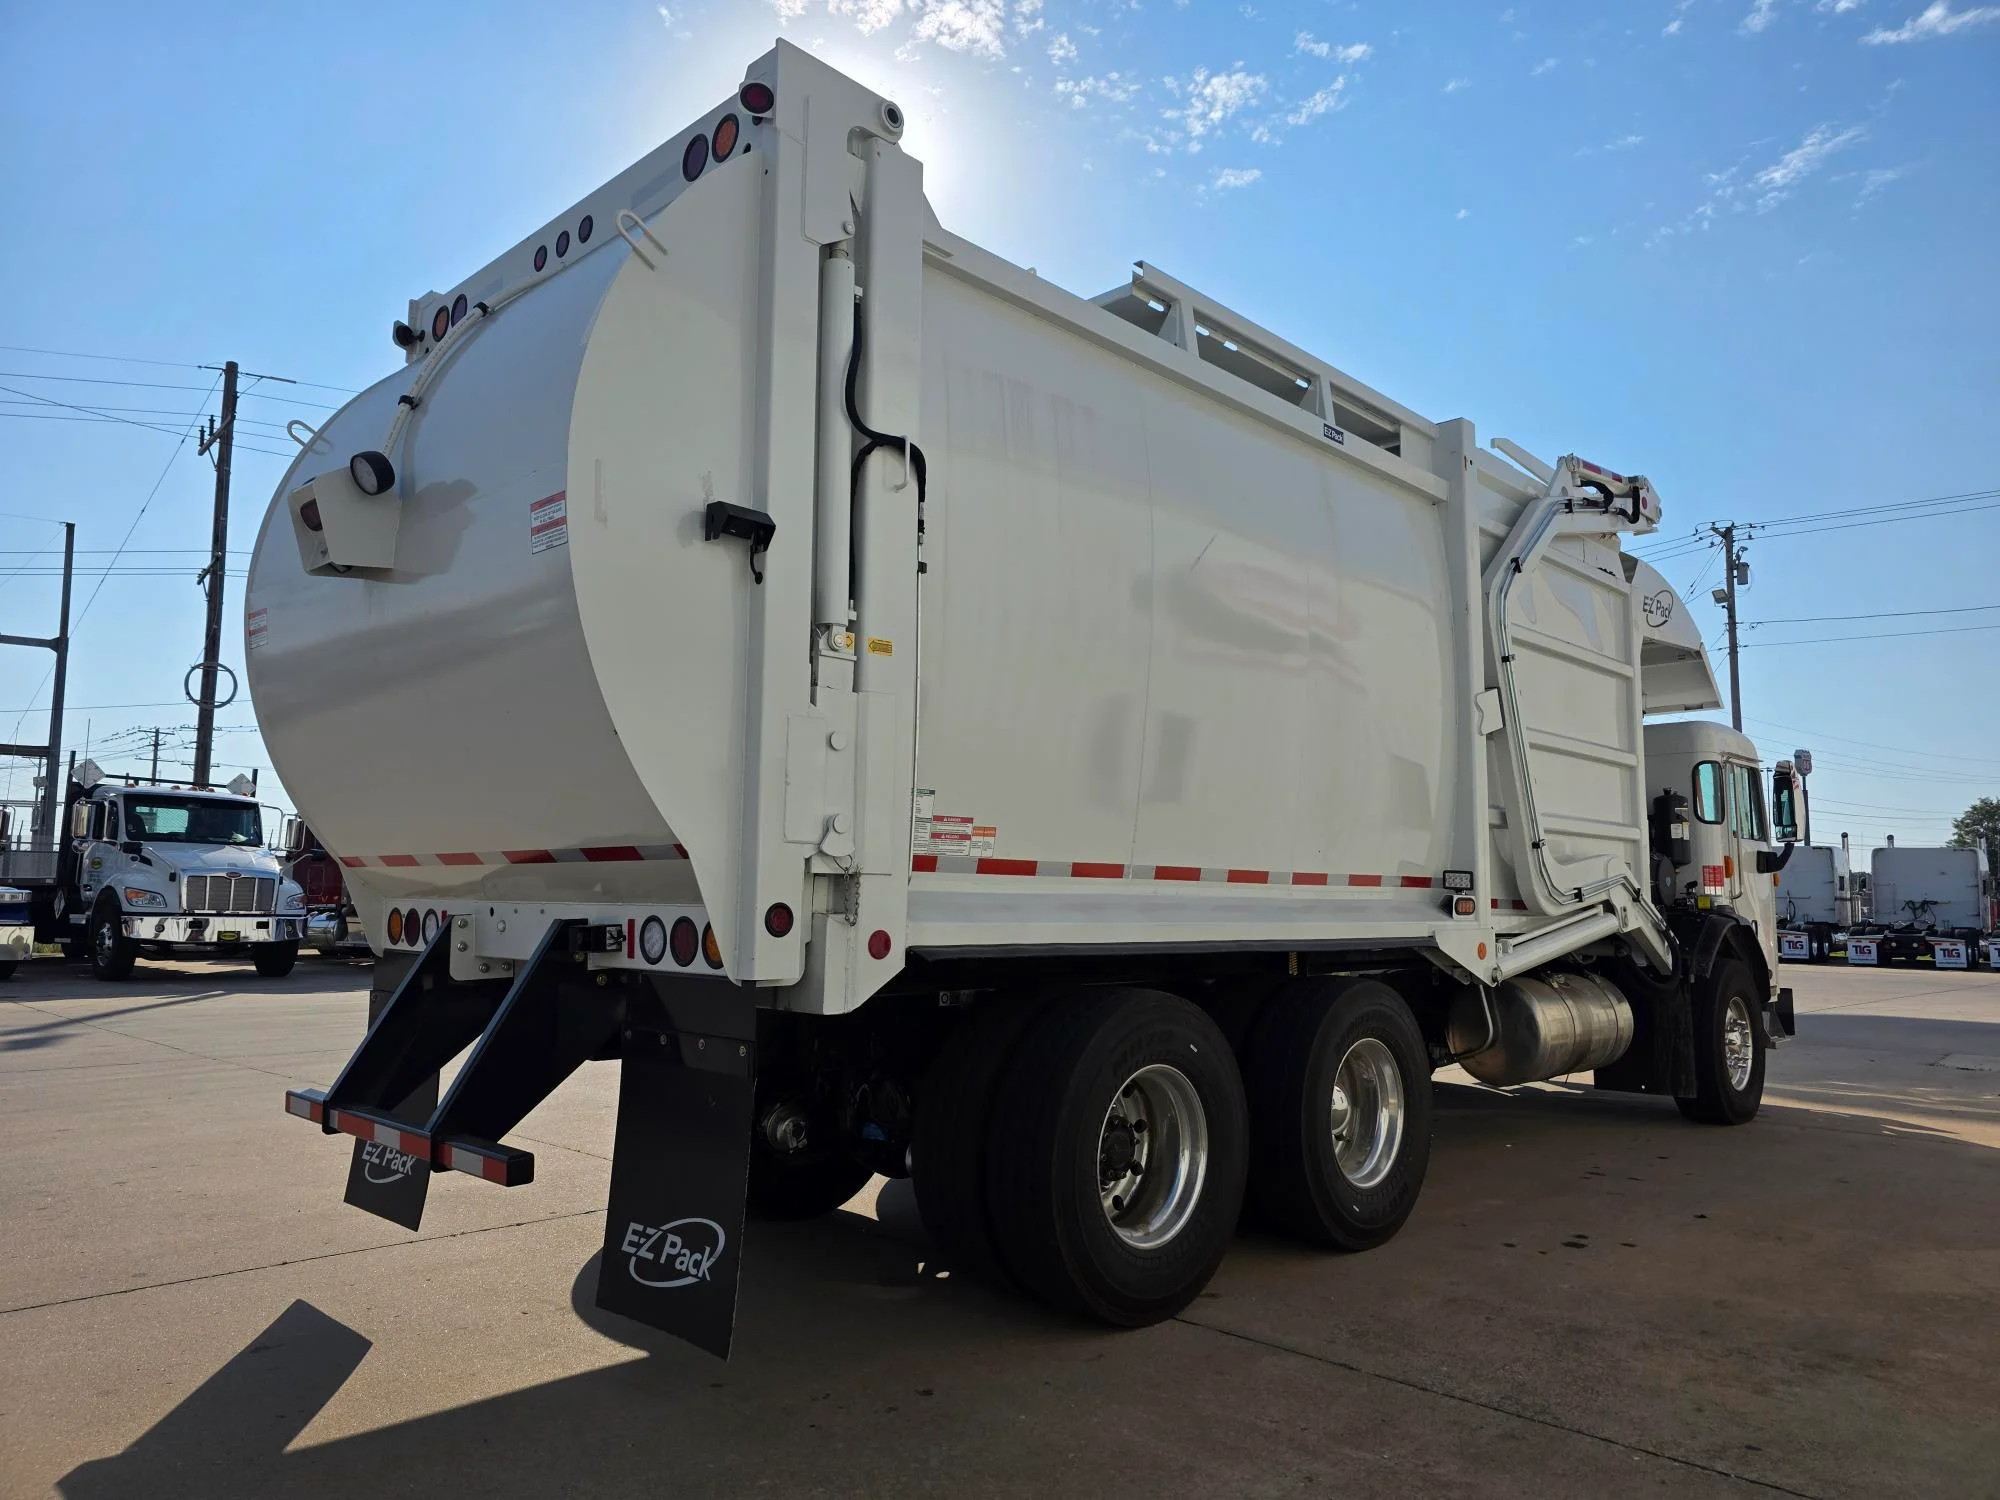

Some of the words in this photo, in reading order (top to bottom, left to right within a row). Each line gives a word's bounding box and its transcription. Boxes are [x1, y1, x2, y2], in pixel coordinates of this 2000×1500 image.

[1655, 599, 1672, 620] Pack
[1852, 945, 1872, 955] TLG
[1940, 948, 1961, 958] TLG
[382, 1147, 416, 1176] Pack
[659, 1233, 711, 1281] Pack
